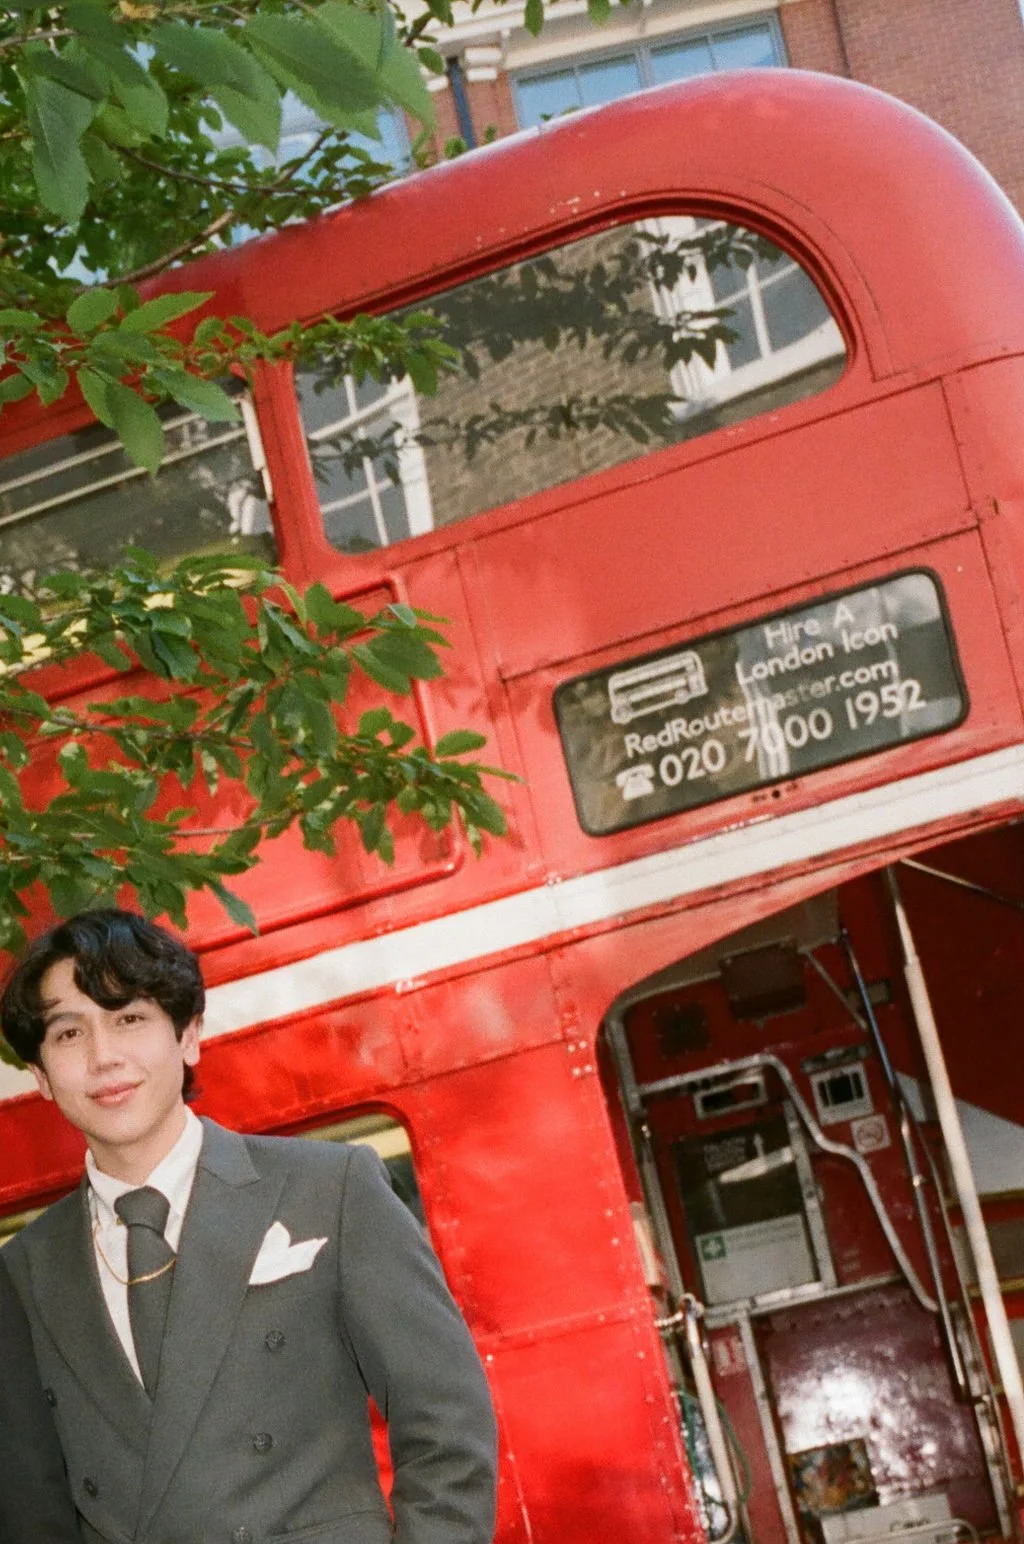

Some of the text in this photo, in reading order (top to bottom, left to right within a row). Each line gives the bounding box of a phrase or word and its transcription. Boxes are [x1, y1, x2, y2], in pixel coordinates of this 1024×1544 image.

[735, 622, 898, 686] London Icon
[764, 602, 855, 648] Hire A
[659, 679, 926, 786] 020 7000 1952
